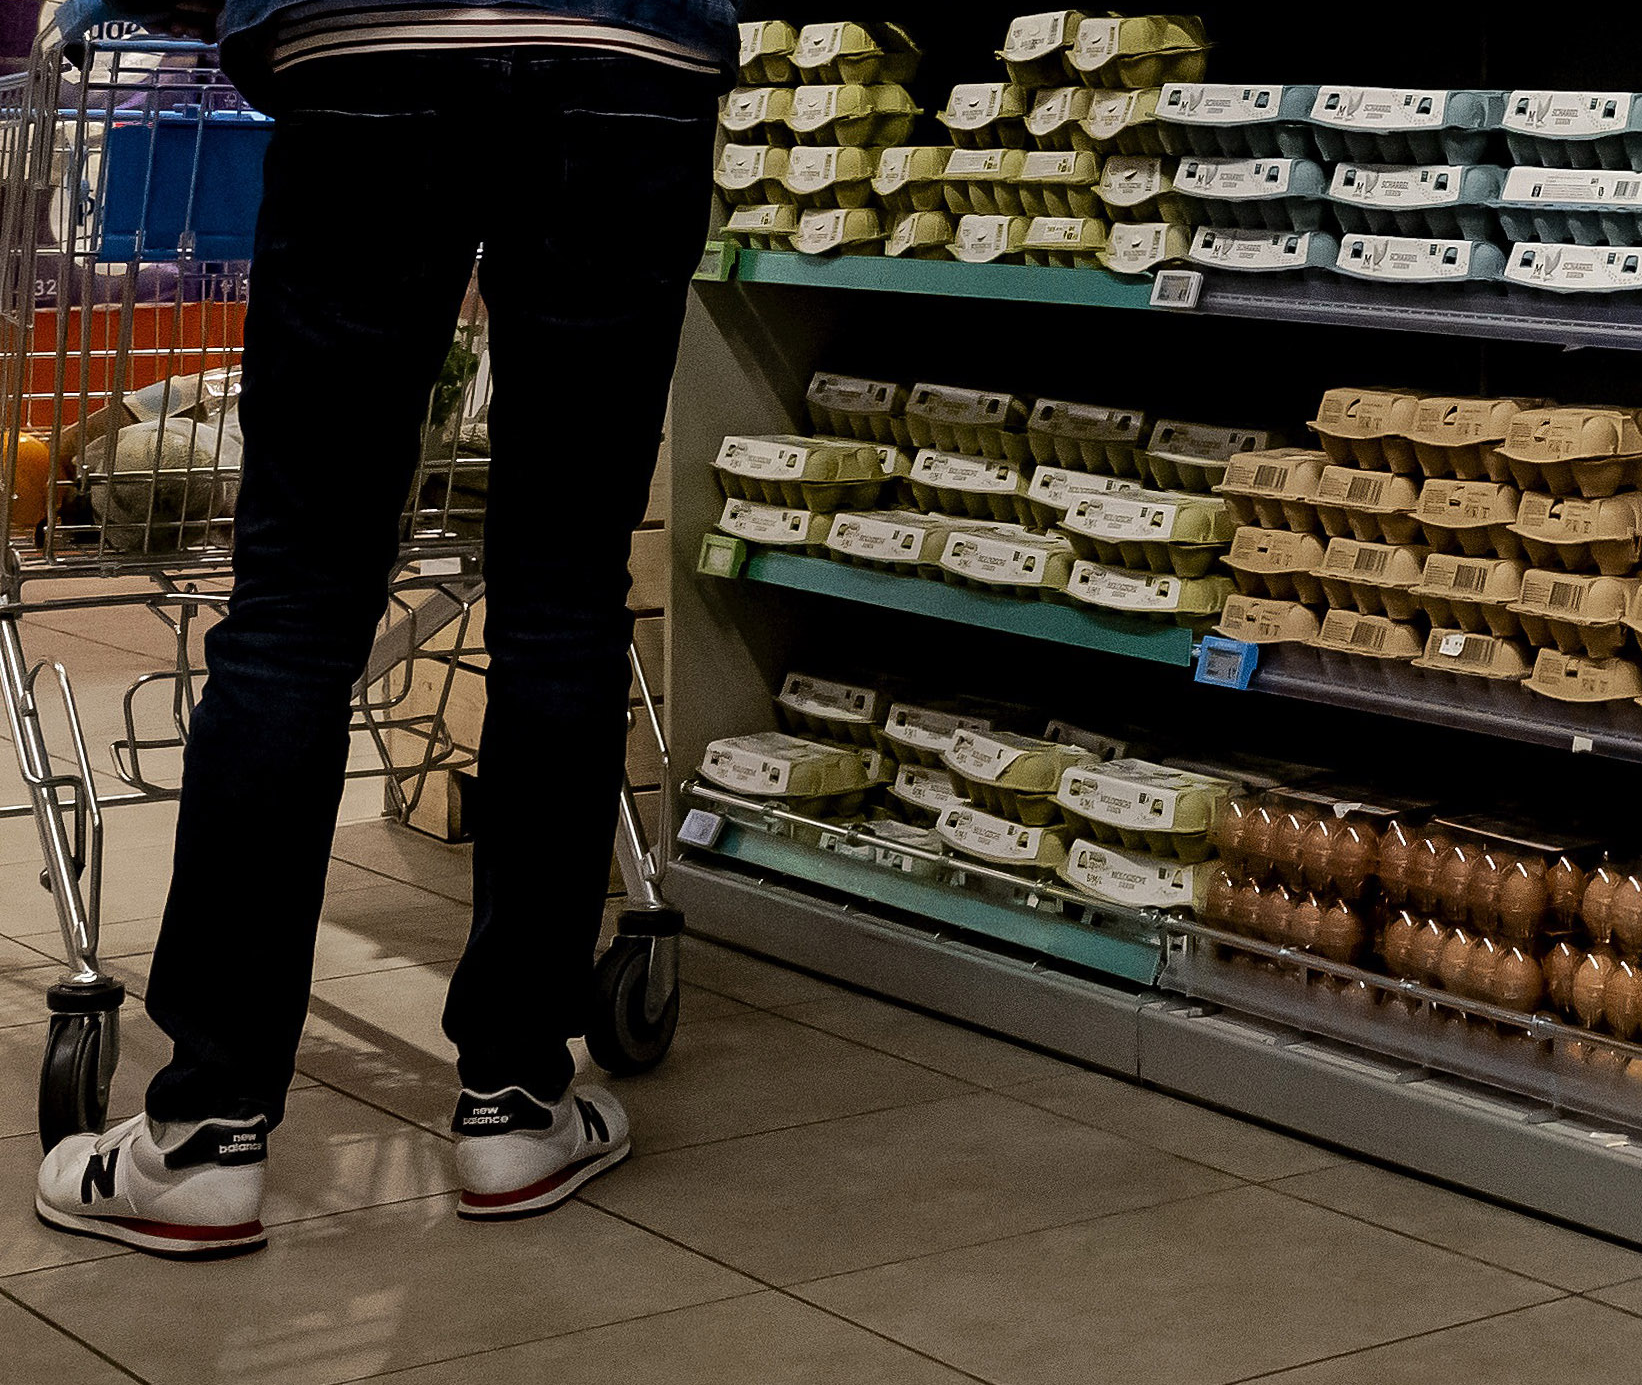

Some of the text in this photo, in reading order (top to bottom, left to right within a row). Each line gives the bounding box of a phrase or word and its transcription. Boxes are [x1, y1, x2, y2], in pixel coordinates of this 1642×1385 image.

[473, 1107, 498, 1115] new
[233, 1134, 256, 1142] new
[219, 1143, 262, 1154] balance
[81, 1148, 119, 1204] N
